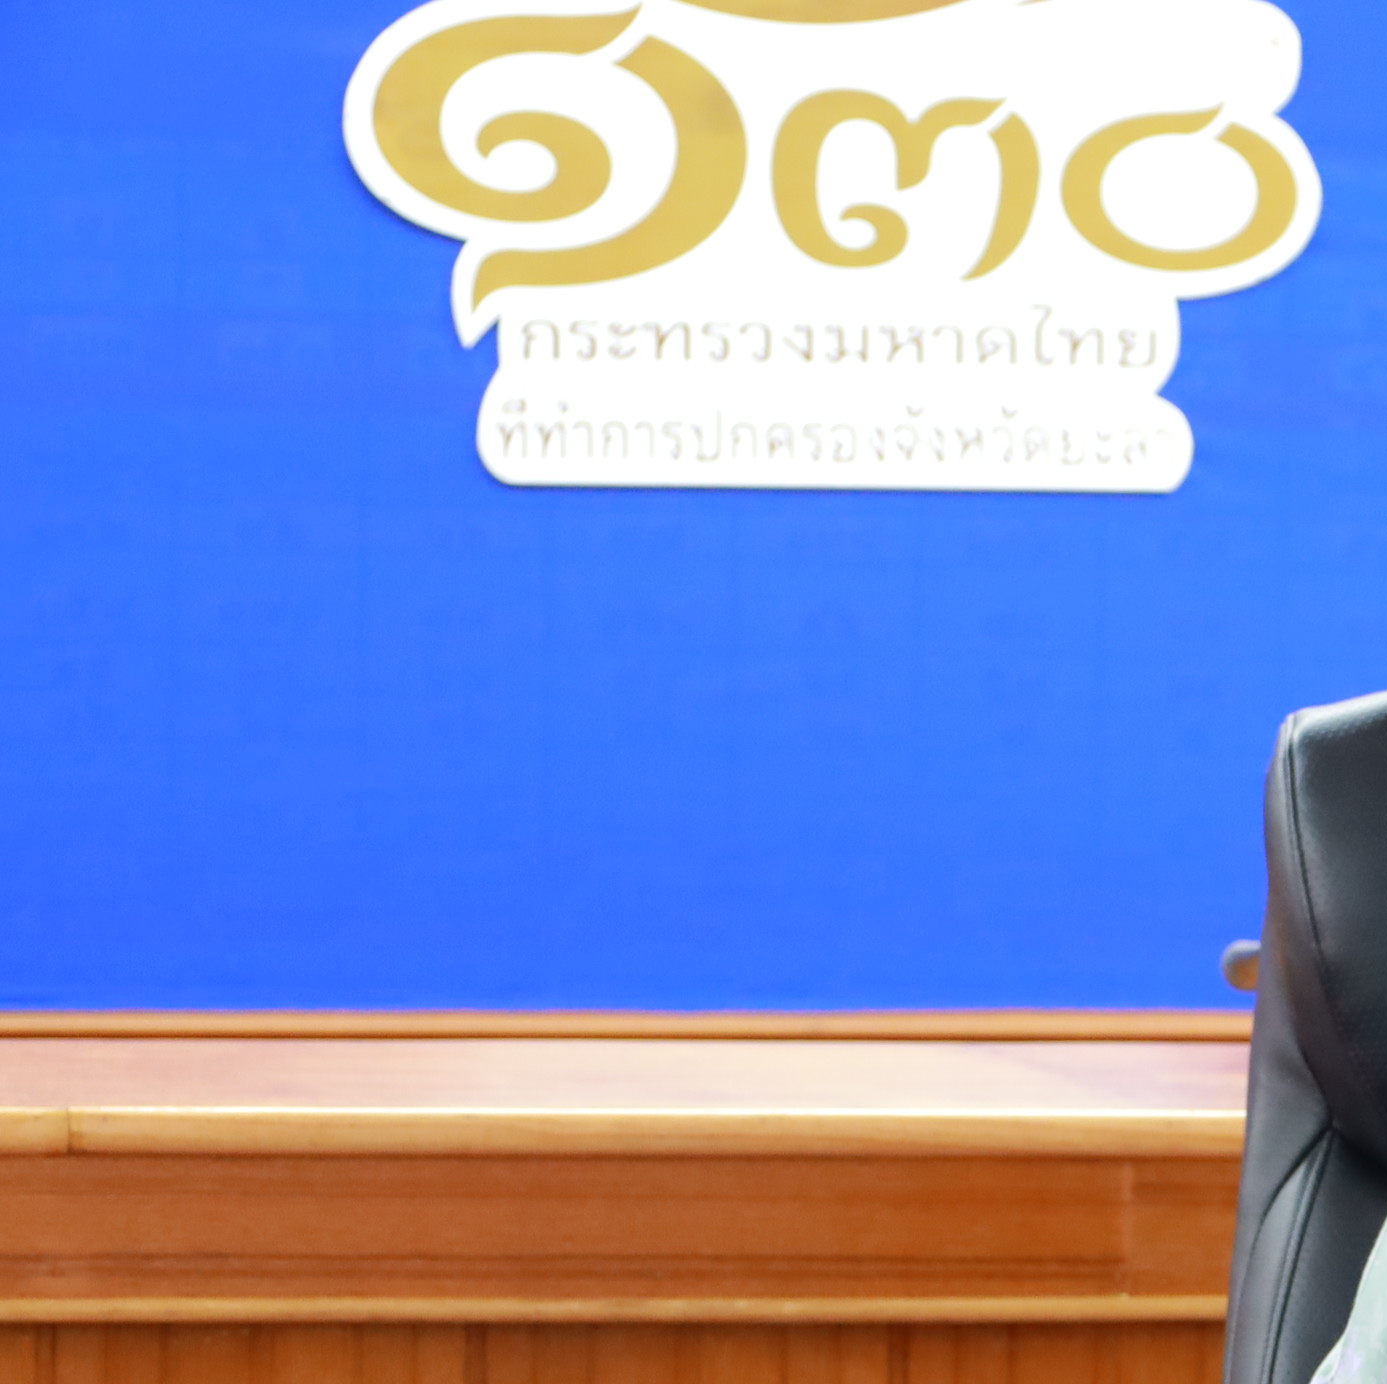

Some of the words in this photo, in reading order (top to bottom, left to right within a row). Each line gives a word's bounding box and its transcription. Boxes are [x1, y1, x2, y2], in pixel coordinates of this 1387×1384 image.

[520, 303, 1157, 367] กระทรวงมหาดไทย
